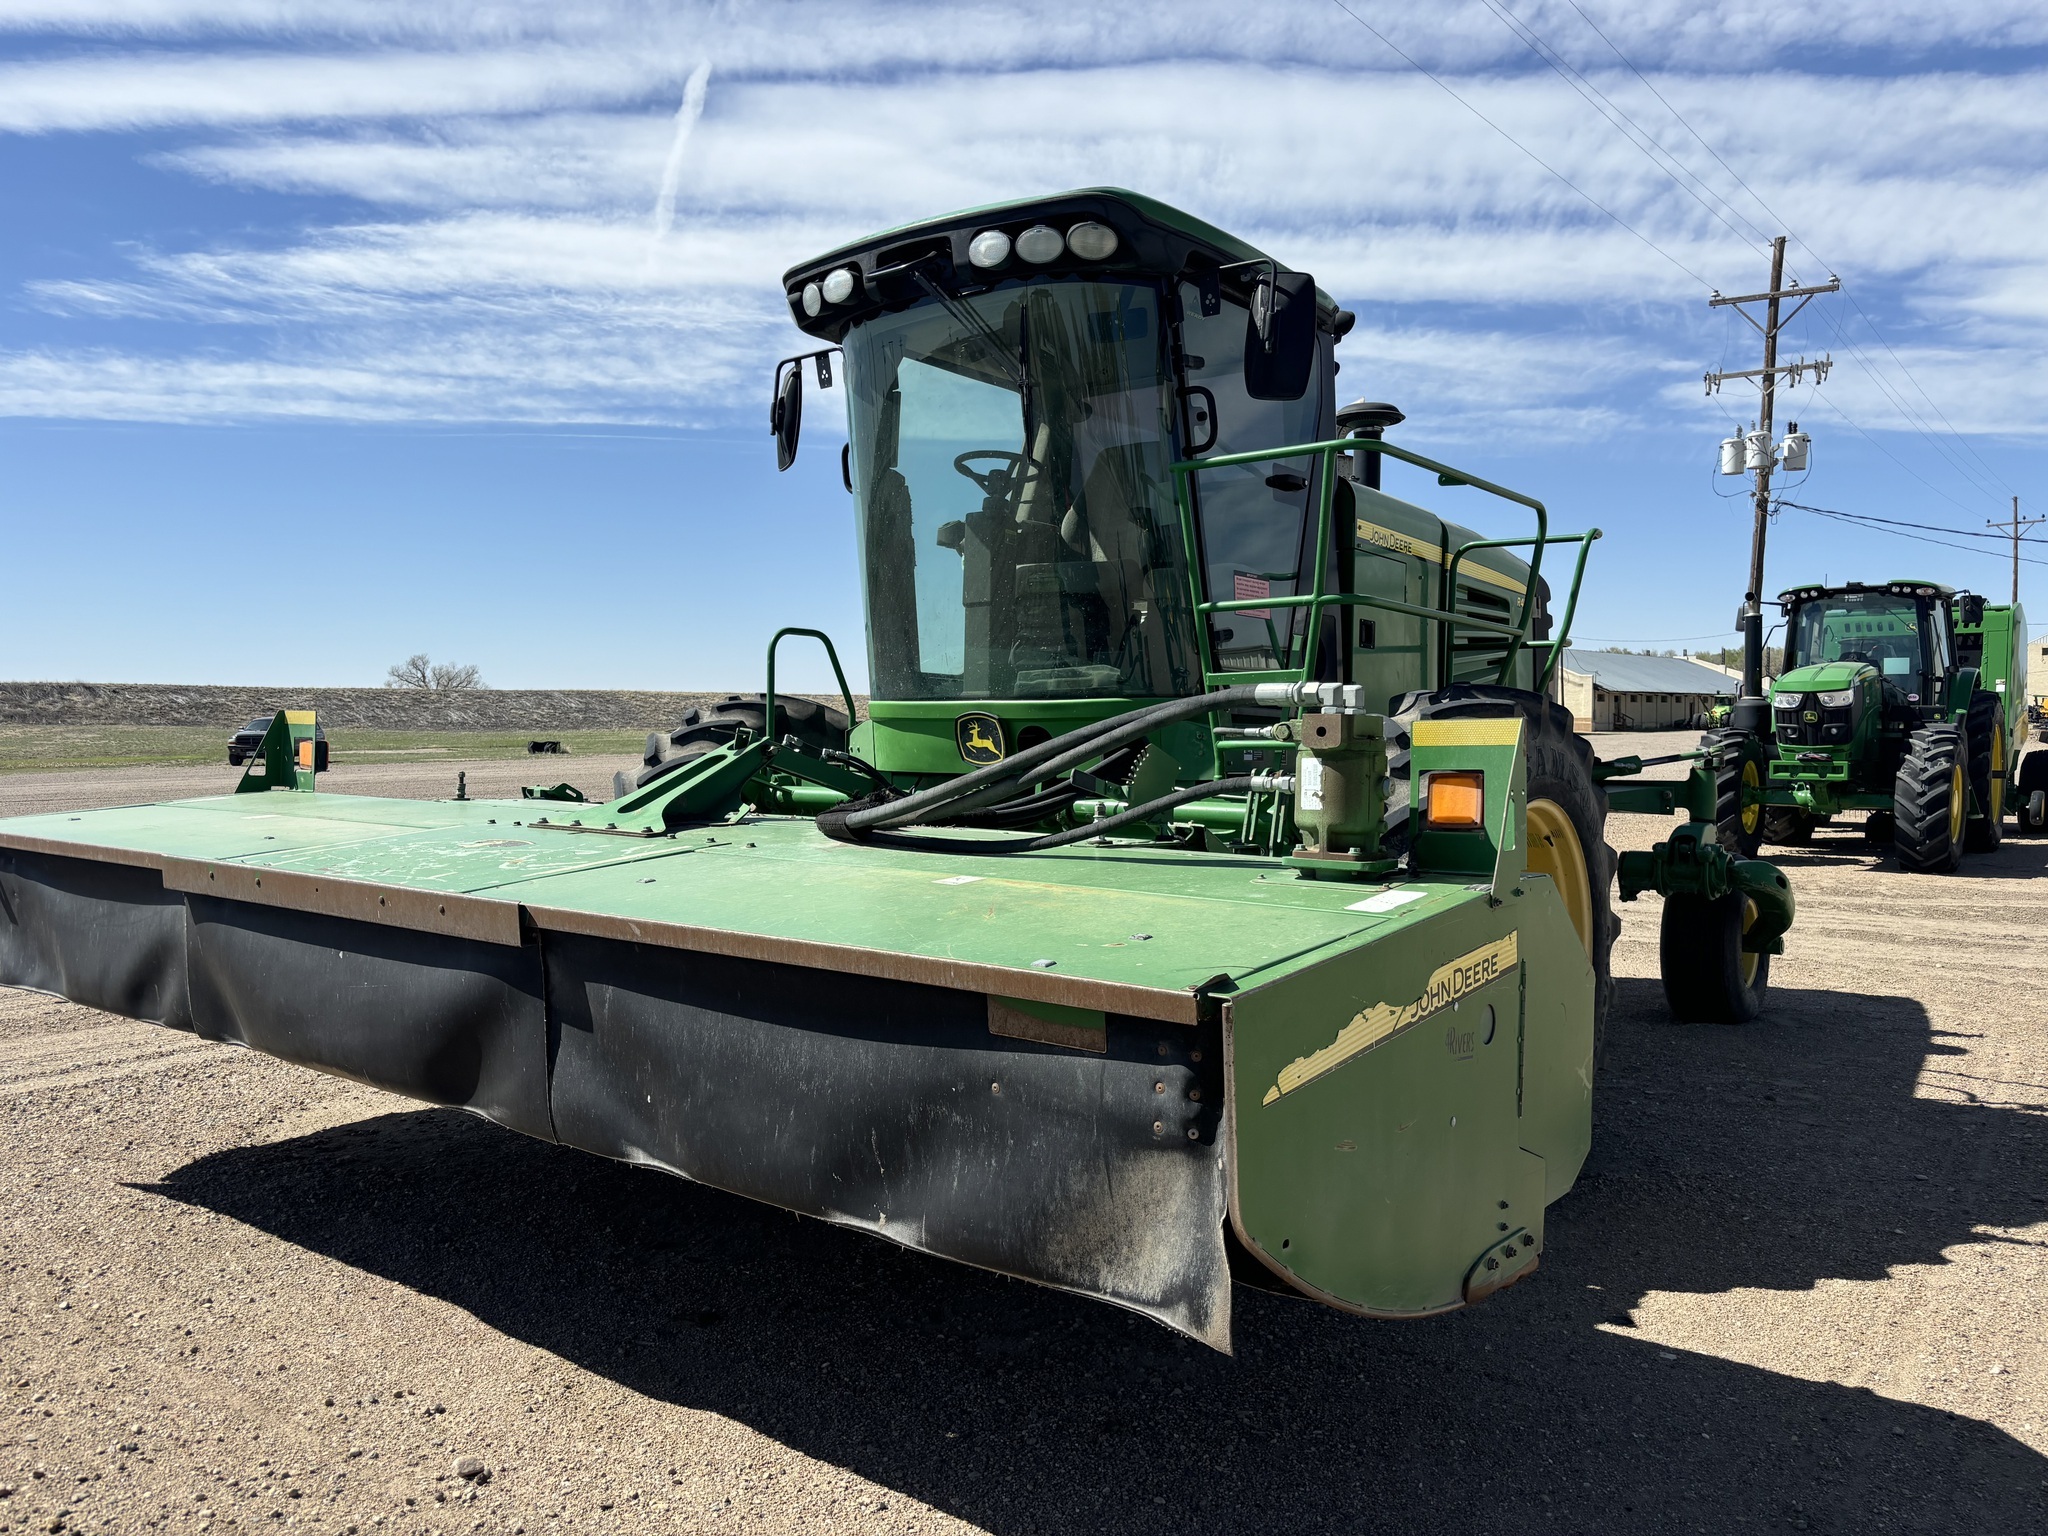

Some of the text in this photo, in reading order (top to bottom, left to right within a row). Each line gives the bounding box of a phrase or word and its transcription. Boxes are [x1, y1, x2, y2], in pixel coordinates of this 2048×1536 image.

[1370, 527, 1412, 553] JOHN DEERE
[1410, 953, 1499, 1018] JOHN DEERE
